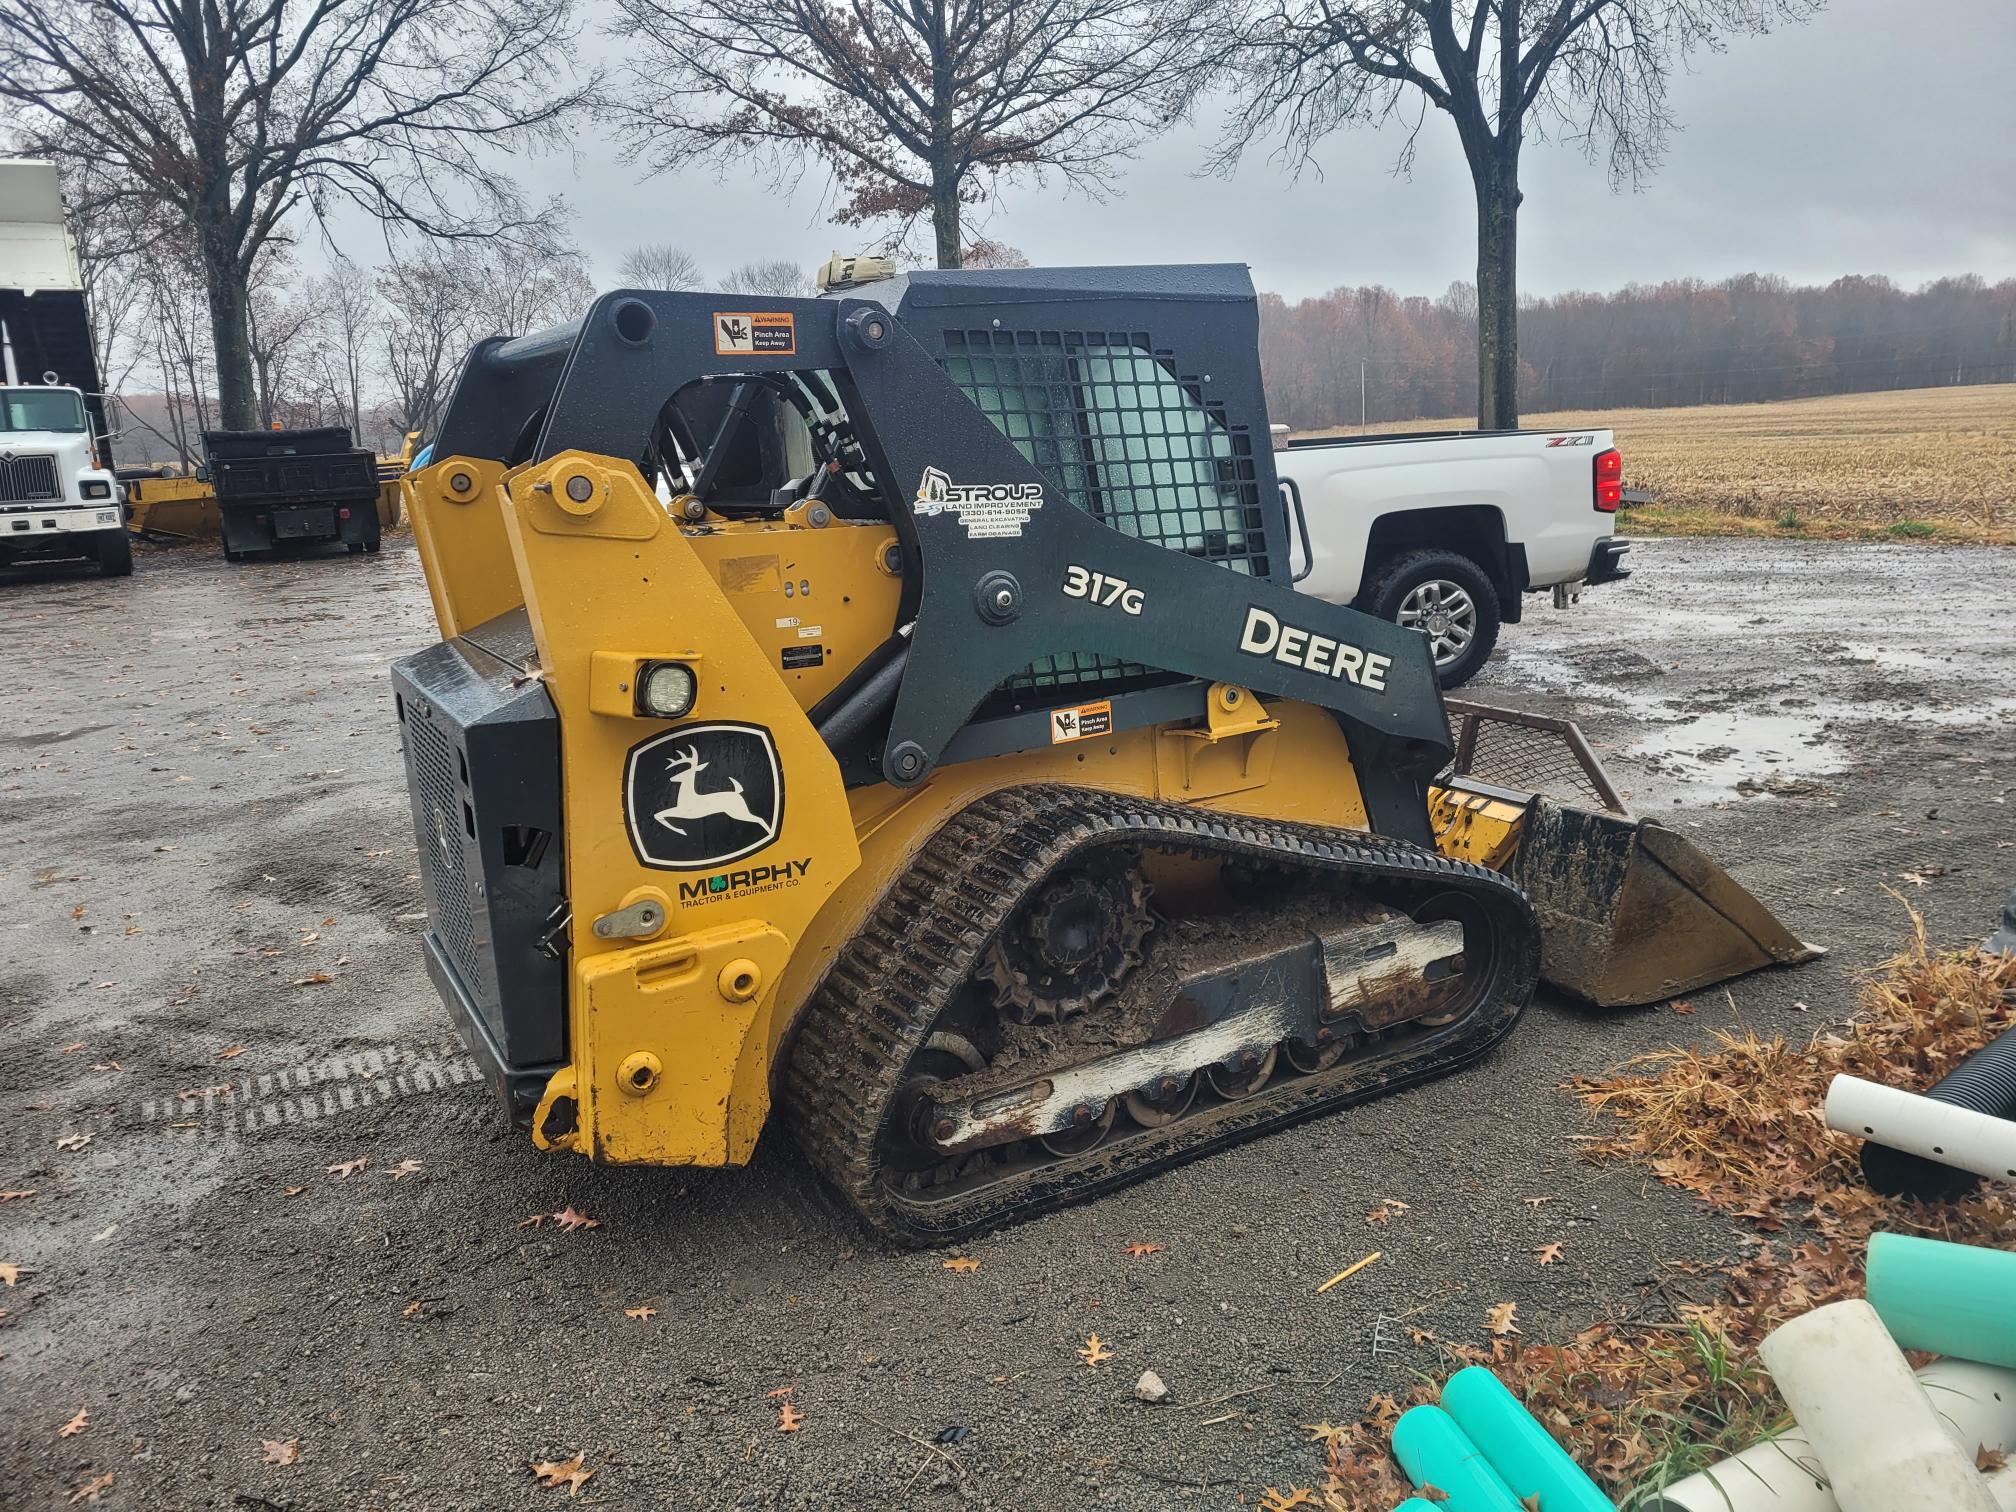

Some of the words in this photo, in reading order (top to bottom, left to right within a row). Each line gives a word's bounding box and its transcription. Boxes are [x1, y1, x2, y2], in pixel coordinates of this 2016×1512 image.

[945, 485, 1041, 502] STROUP
[973, 501, 1041, 509] IMPROVEMENT
[962, 508, 1027, 517] (330)-614-9052
[1063, 565, 1145, 615] 317G
[1240, 607, 1392, 691] DEERE
[679, 858, 812, 900] MURPHY
[680, 894, 723, 909] TRACTOR
[725, 892, 731, 900] &
[733, 881, 784, 899] EQUIPMENT
[785, 878, 801, 888] CO.
